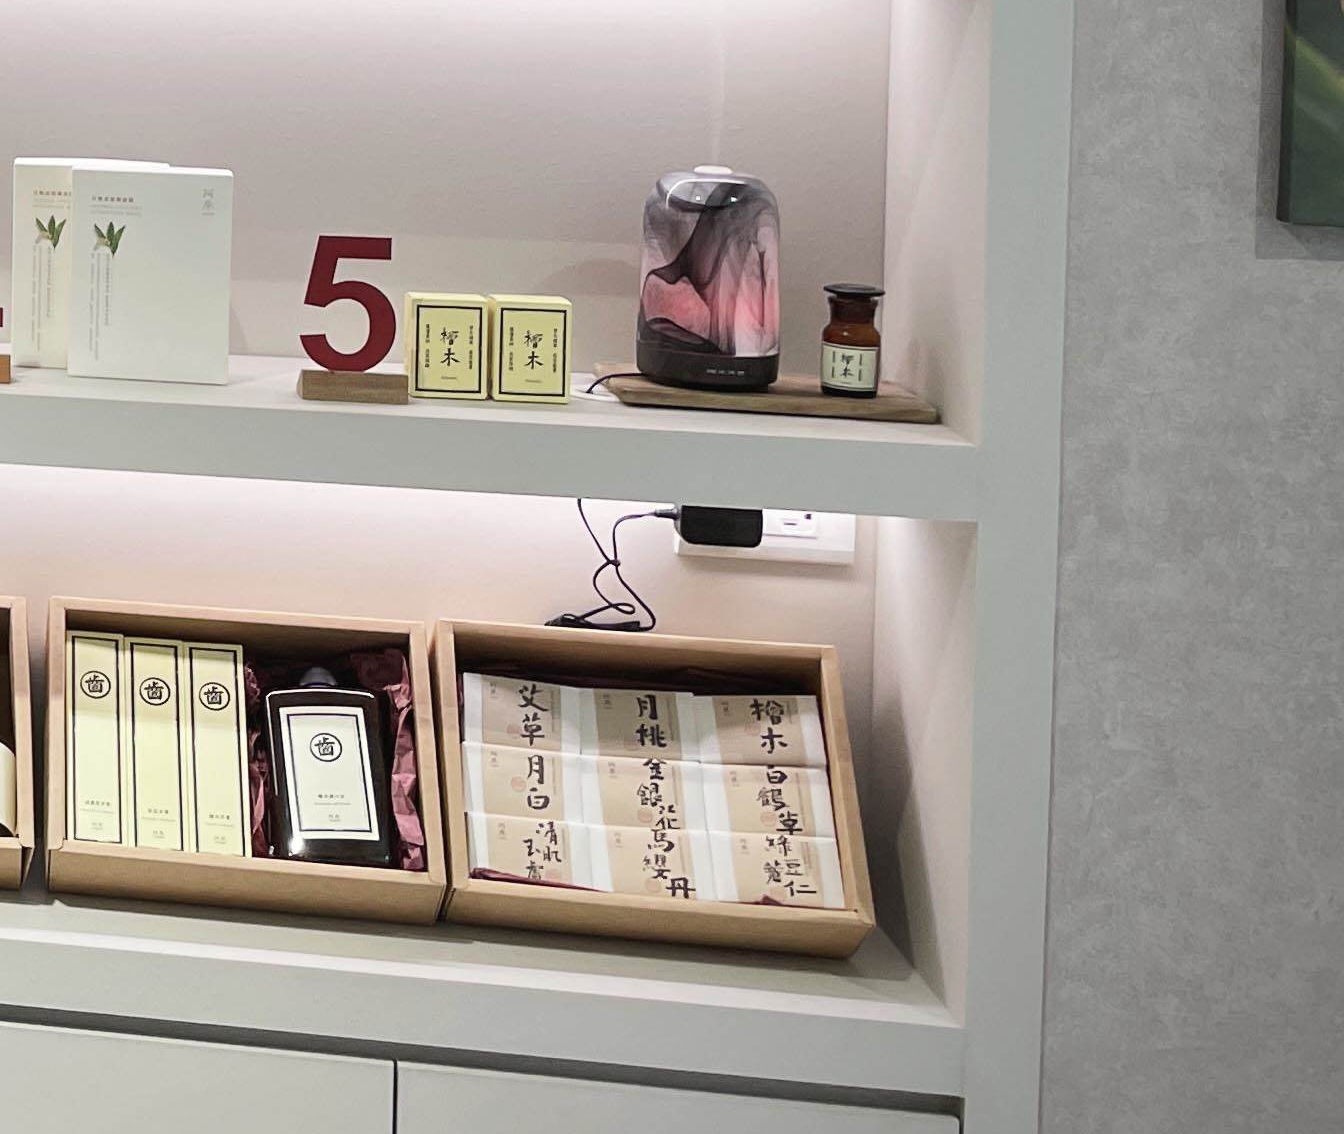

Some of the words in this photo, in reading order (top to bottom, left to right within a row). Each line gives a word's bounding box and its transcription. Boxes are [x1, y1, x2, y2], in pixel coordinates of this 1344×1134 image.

[299, 235, 397, 373] 5
[518, 683, 550, 747] 艾草
[635, 694, 668, 748] 月桃
[750, 698, 788, 754] 檜木
[527, 754, 551, 810] 月白
[636, 757, 681, 830] 金銀花
[756, 764, 804, 836] 白鶴草
